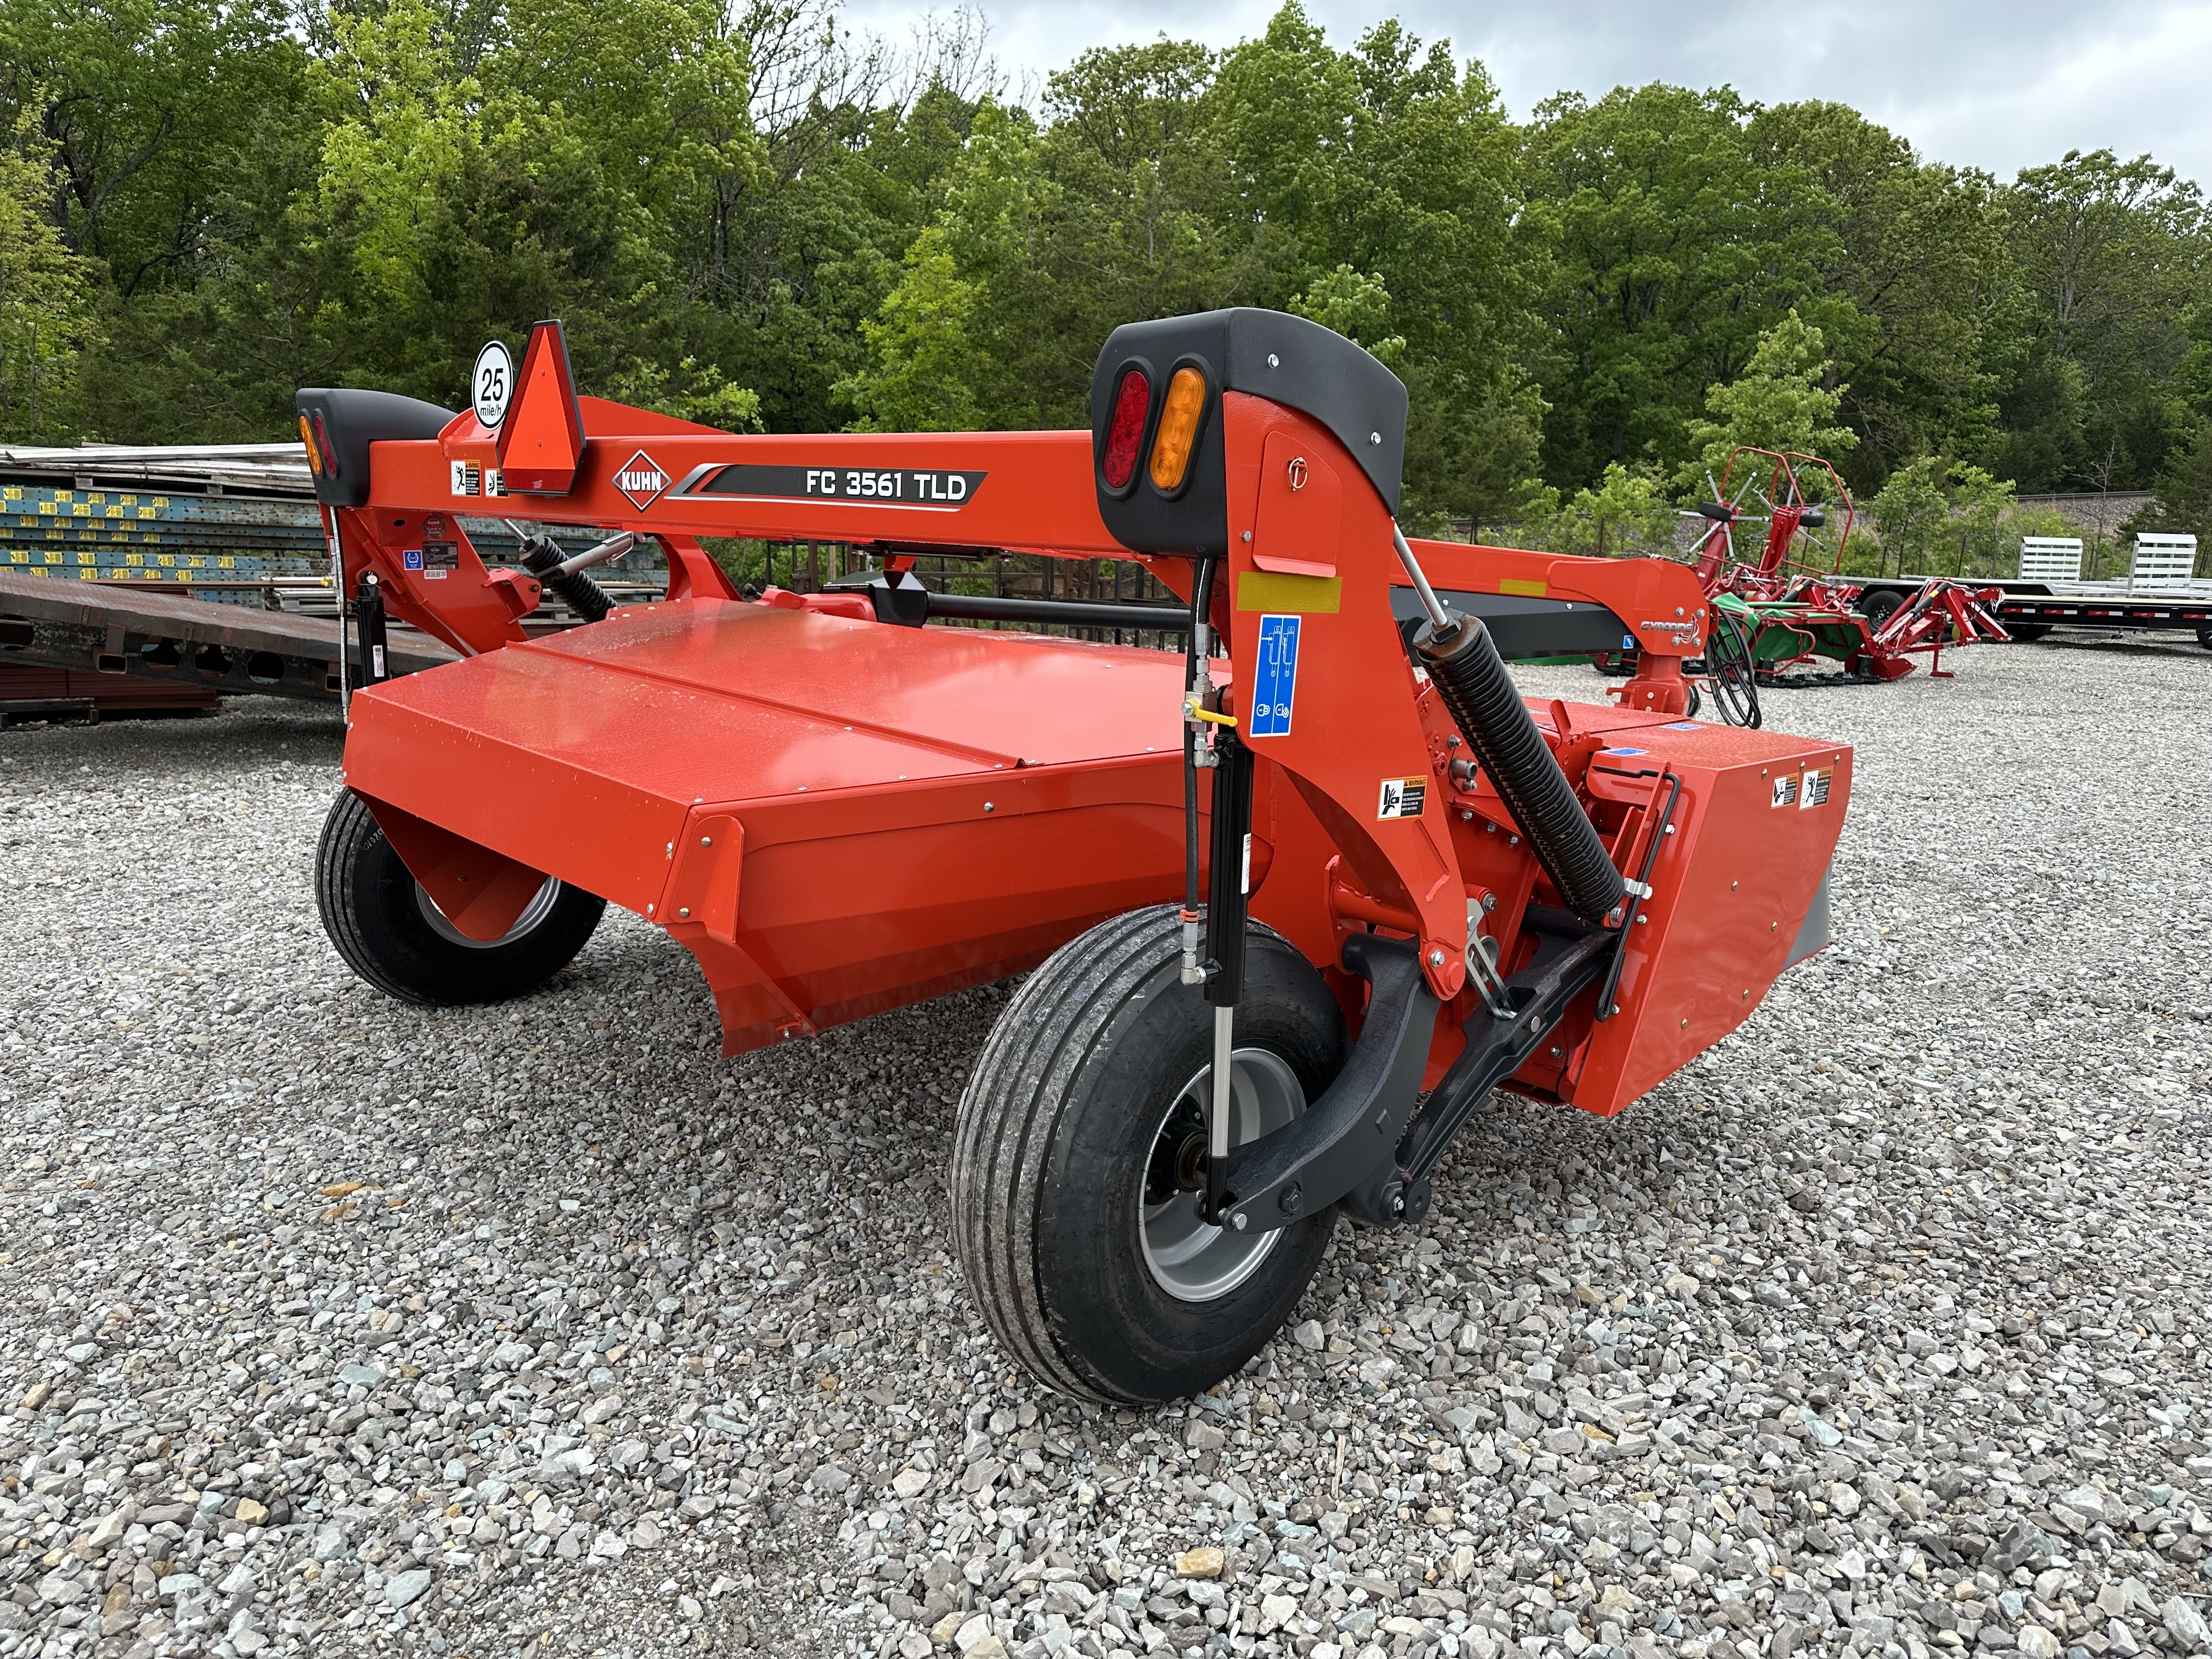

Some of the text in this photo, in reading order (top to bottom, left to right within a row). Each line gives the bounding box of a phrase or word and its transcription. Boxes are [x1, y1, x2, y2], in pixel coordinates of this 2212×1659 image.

[481, 368, 503, 401] 25
[480, 404, 501, 416] mile/h
[622, 471, 661, 491] KUHN
[807, 470, 966, 500] FC 3561 TLD
[1640, 621, 1692, 633] GYRODINE
